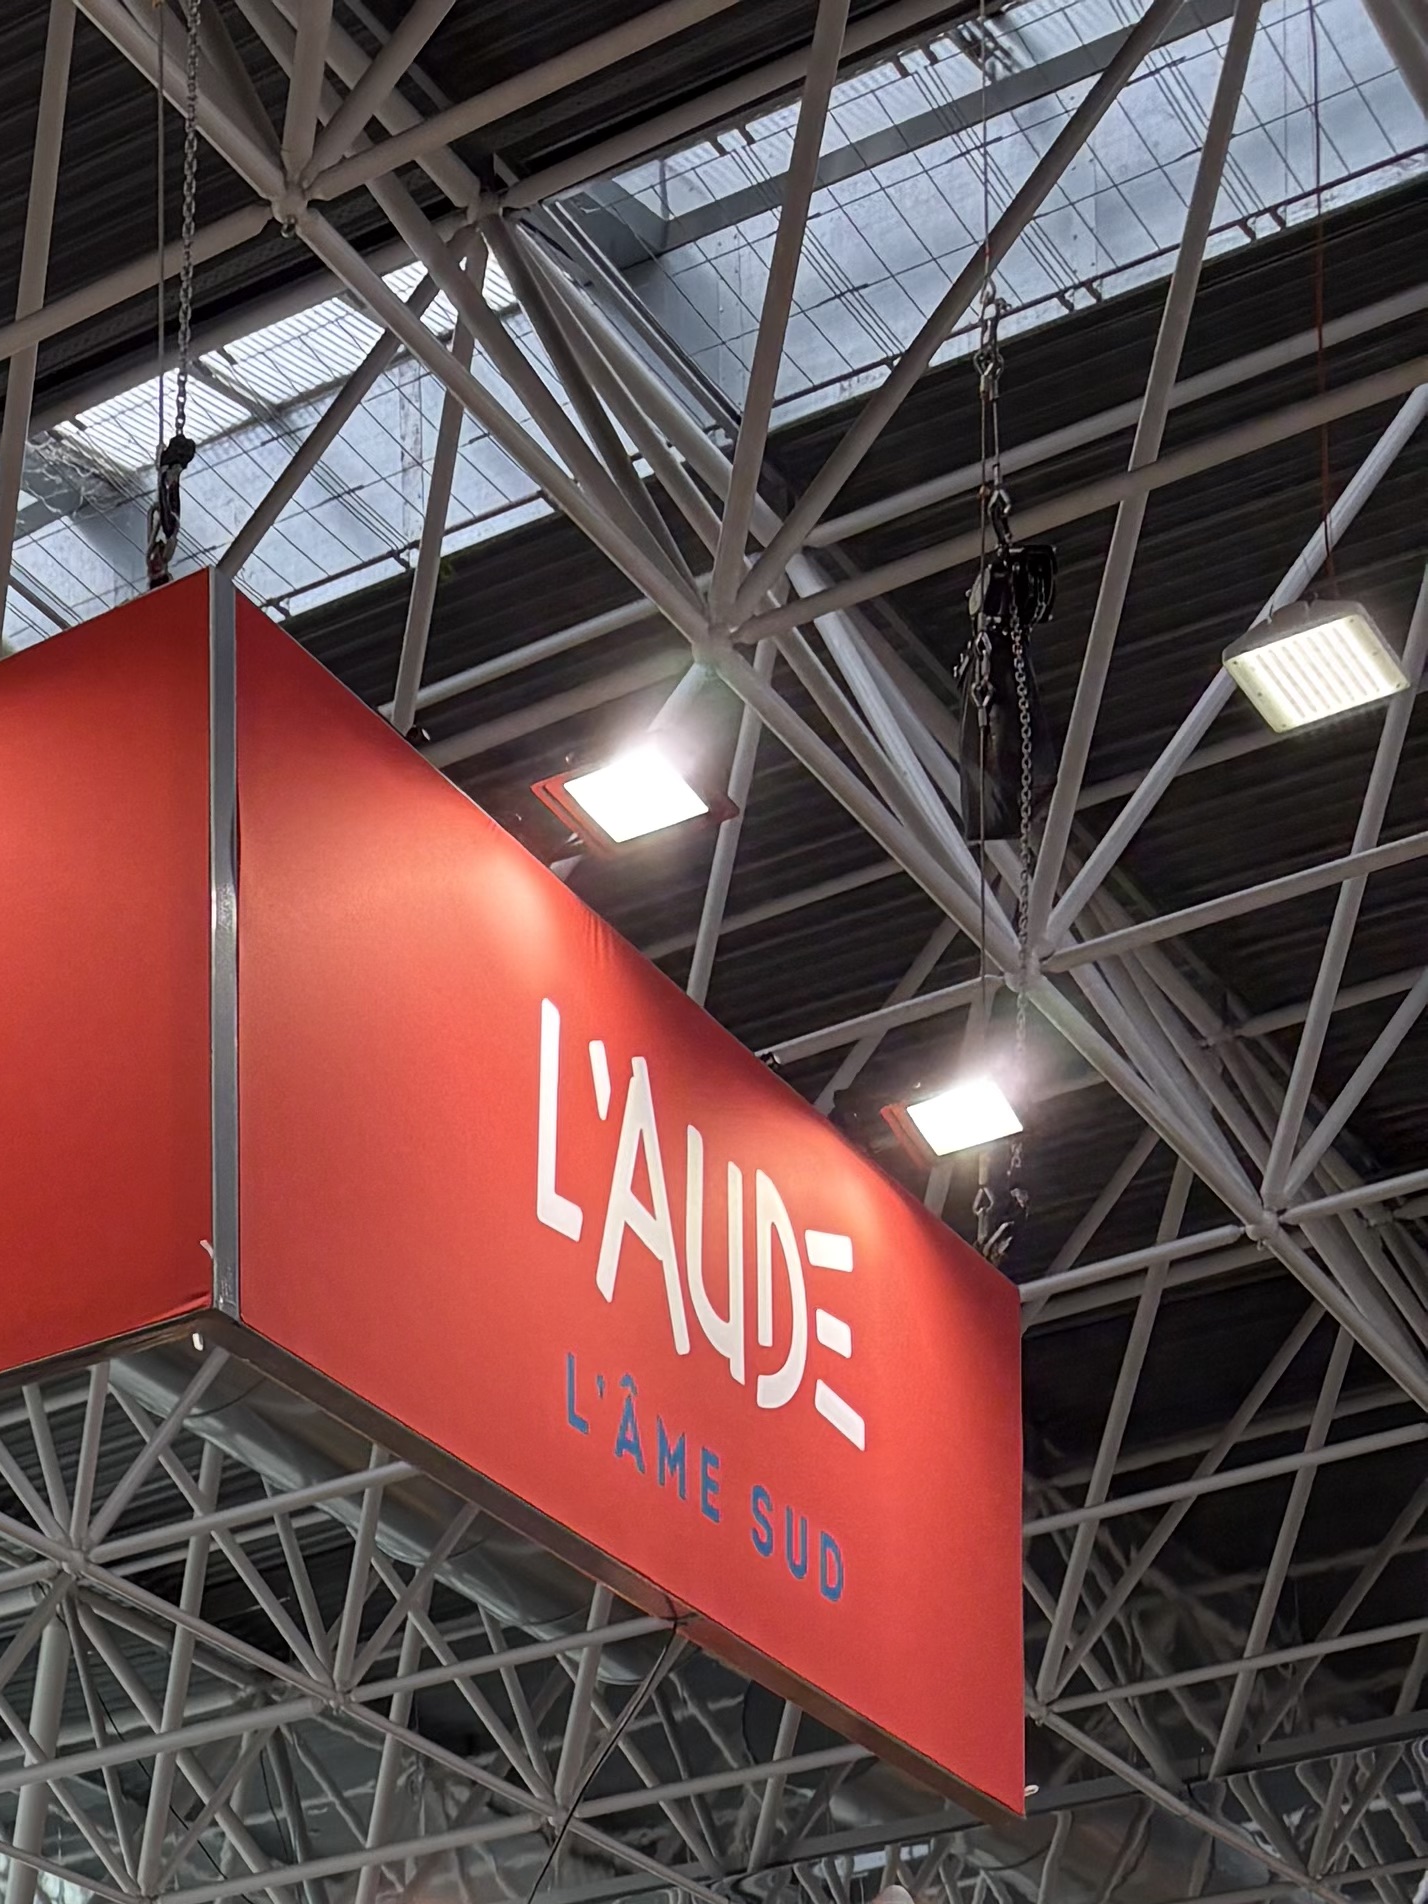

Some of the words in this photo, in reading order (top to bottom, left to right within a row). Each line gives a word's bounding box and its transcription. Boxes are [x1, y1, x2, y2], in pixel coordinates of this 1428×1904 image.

[536, 997, 866, 1451] L'AUDE
[566, 1352, 722, 1524] L'ÂME
[750, 1484, 845, 1603] SUD
